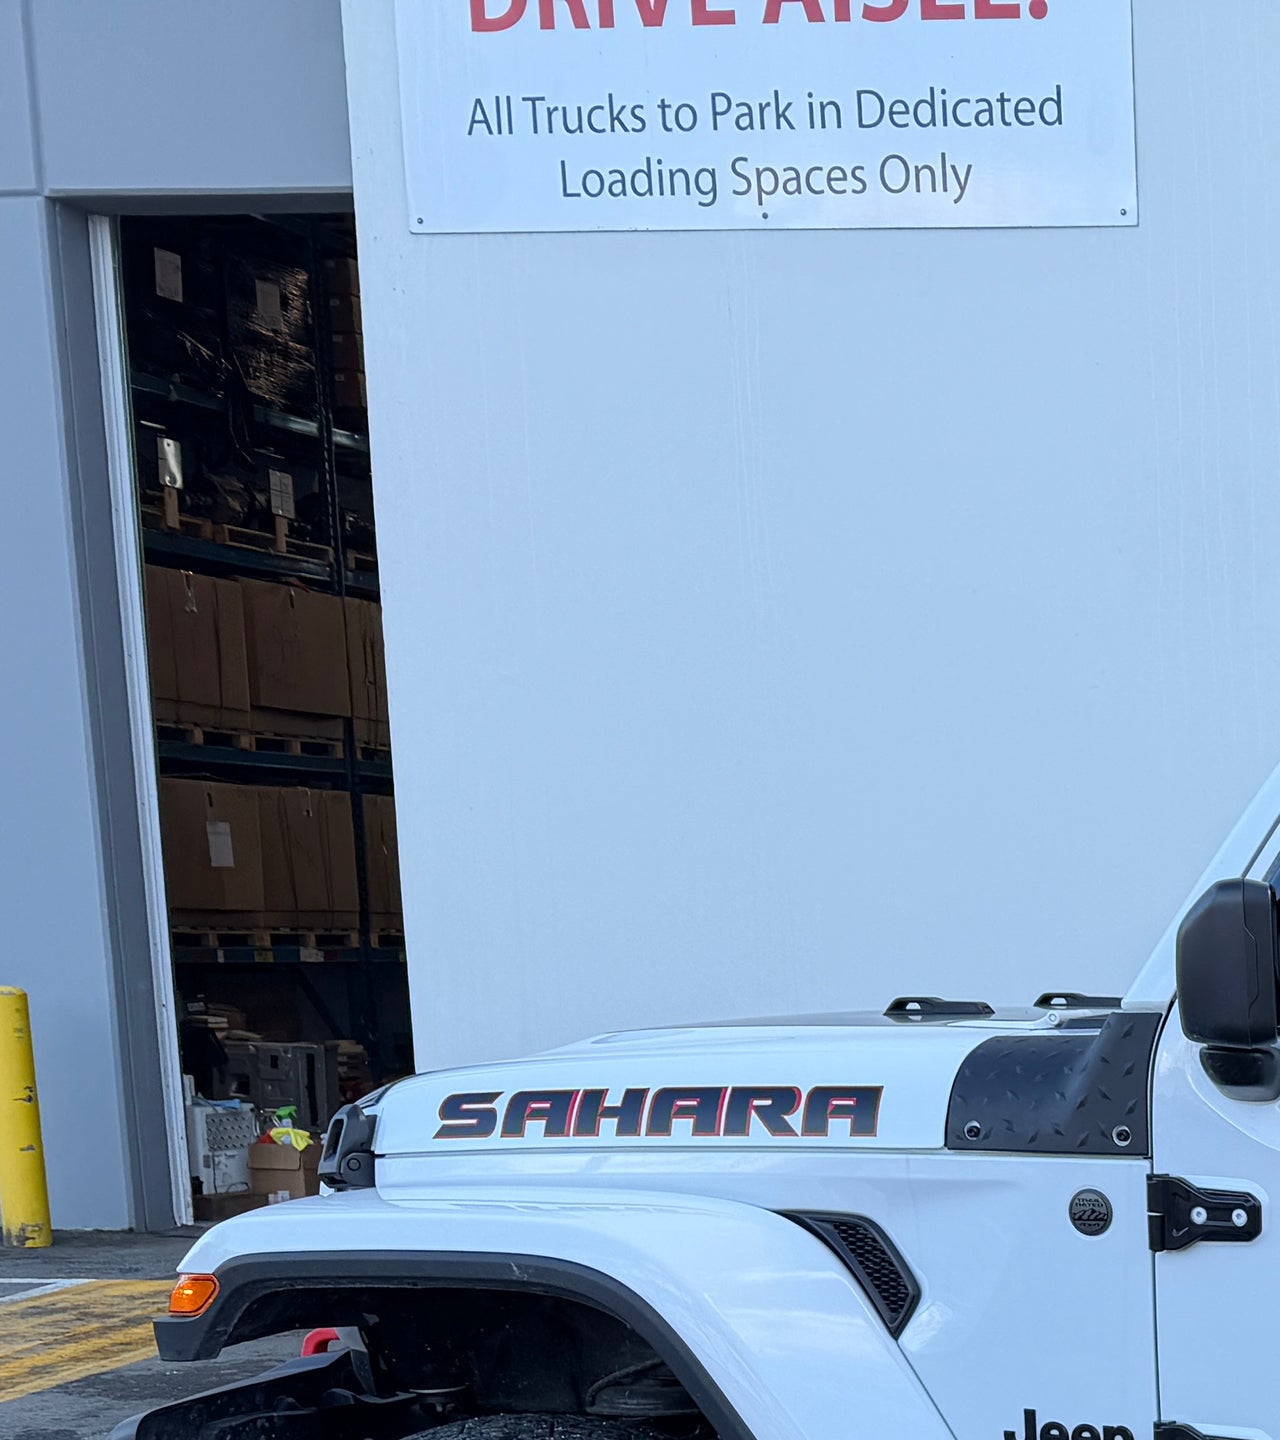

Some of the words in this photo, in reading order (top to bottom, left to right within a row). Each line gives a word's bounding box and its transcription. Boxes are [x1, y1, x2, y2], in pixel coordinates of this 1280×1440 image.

[467, 95, 514, 136] All
[521, 92, 647, 135] Trucks
[657, 97, 699, 133] to
[710, 89, 796, 131] Park
[807, 90, 842, 130] in
[856, 84, 1064, 129] Dedicated
[560, 156, 718, 208] Loading
[731, 156, 868, 206] Spaces
[879, 151, 973, 204] Only
[432, 1085, 885, 1140] SAHARA
